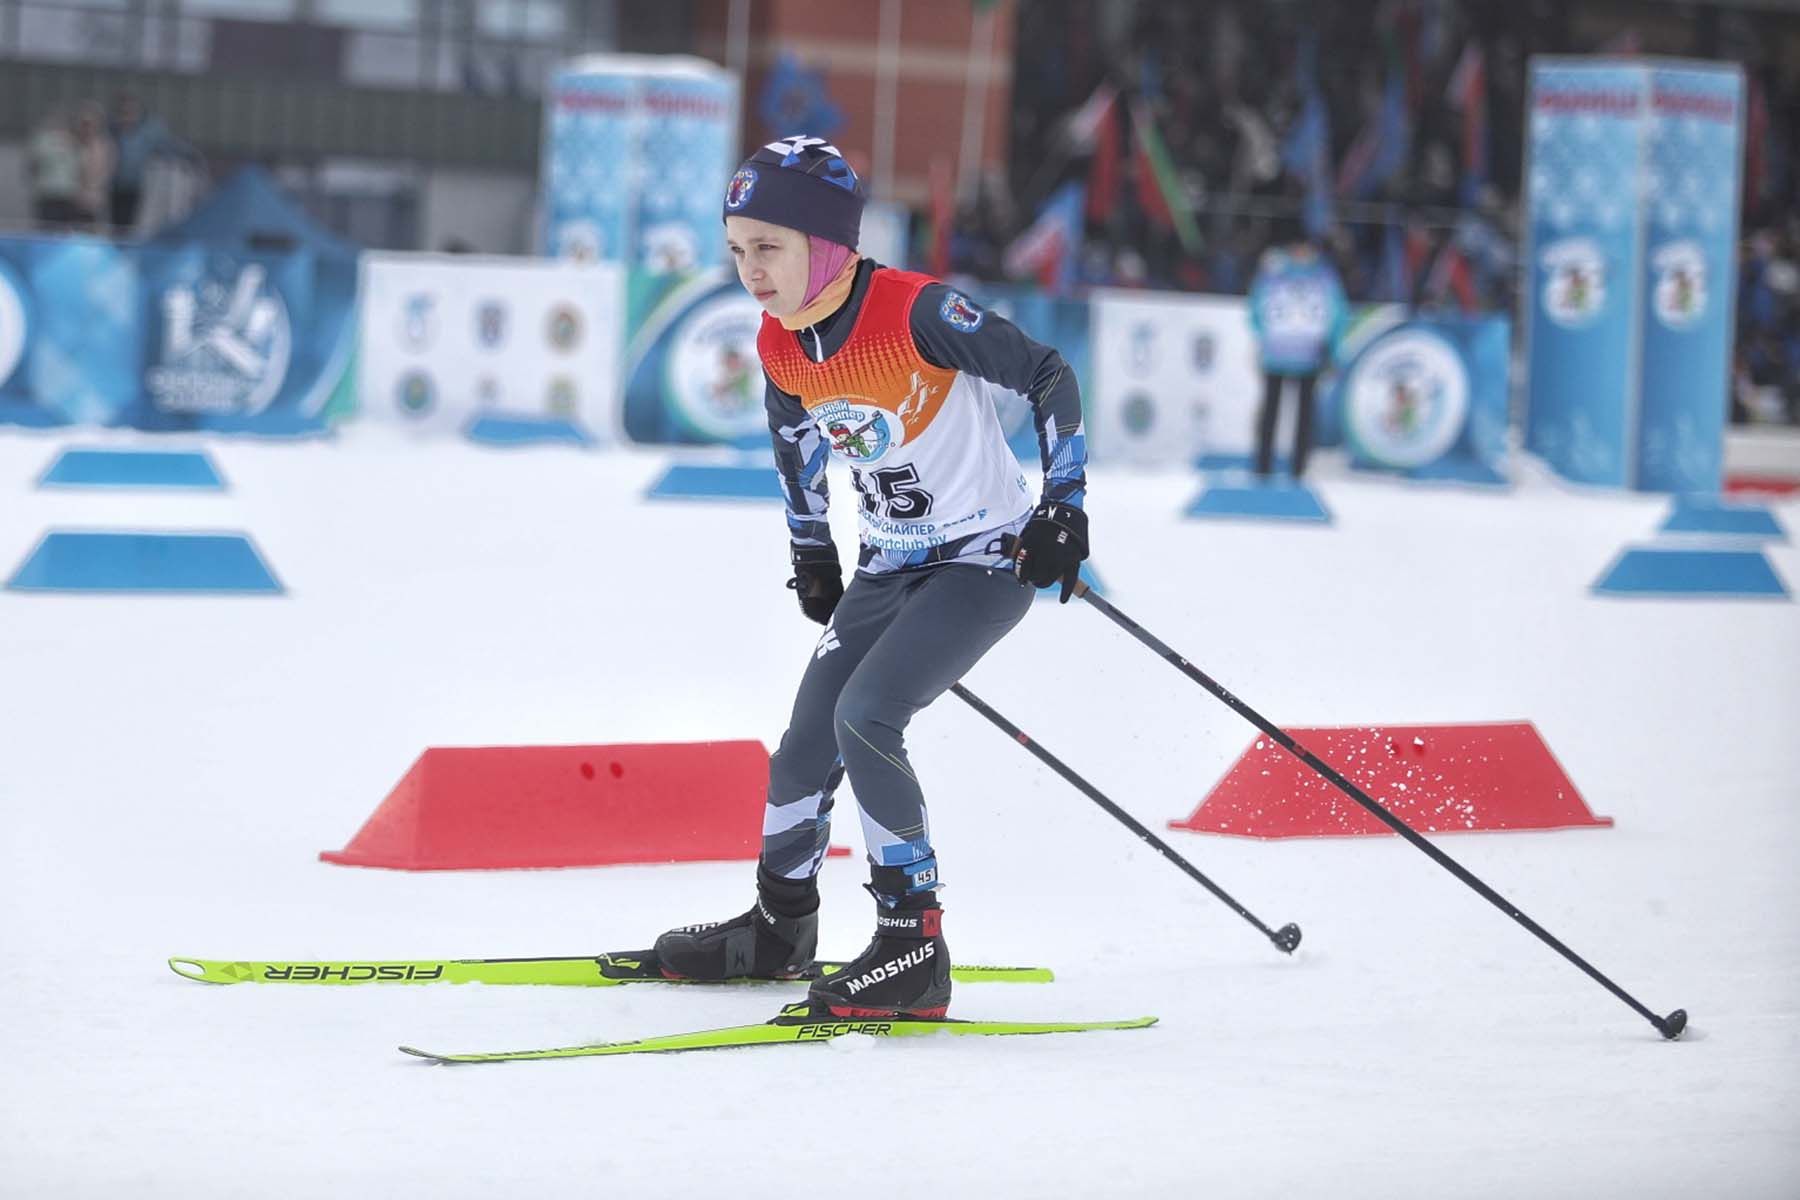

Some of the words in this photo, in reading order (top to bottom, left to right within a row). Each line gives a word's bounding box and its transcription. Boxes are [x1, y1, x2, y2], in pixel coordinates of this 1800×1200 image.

[880, 521, 936, 537] СНАЙПЕР
[917, 869, 933, 884] 45
[264, 964, 444, 981] FISCHER
[846, 941, 936, 995] MADSHUS
[796, 1022, 892, 1040] FISCHER
